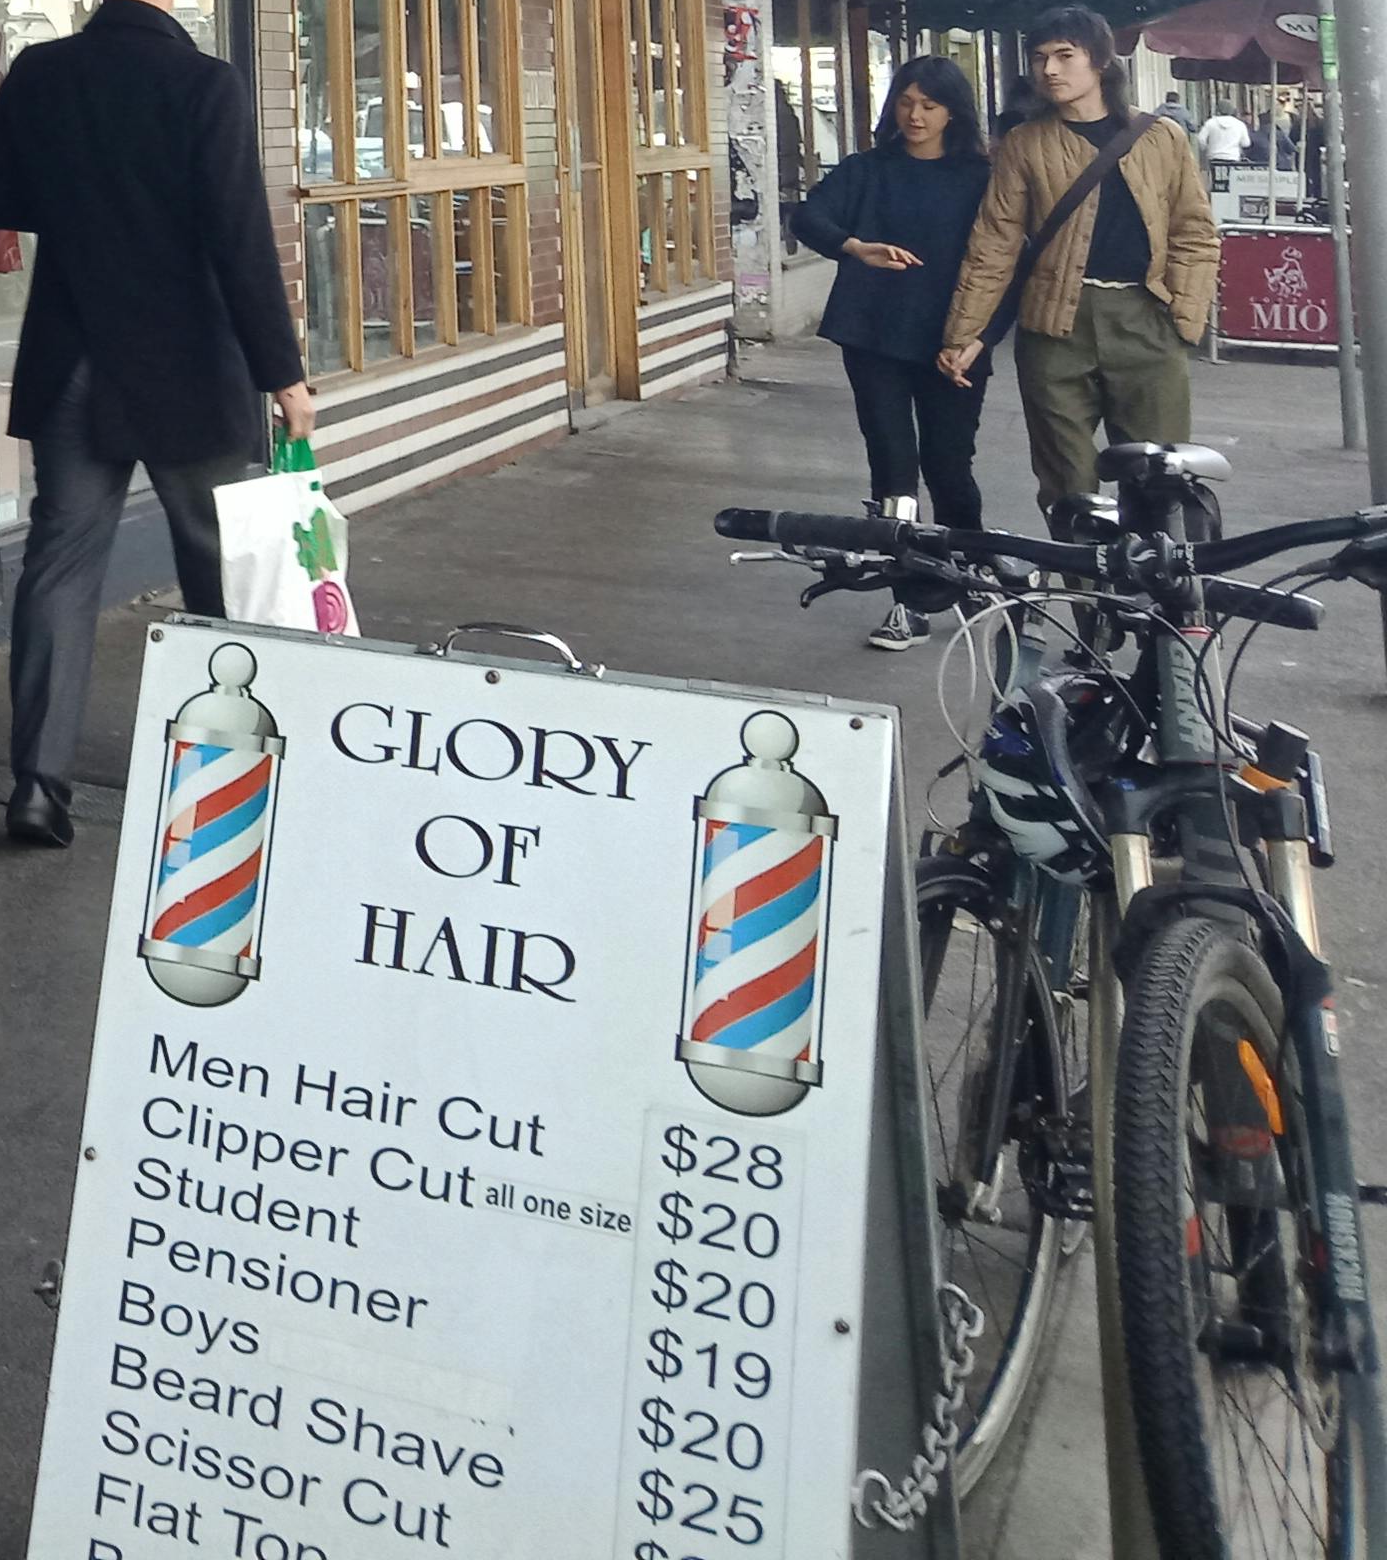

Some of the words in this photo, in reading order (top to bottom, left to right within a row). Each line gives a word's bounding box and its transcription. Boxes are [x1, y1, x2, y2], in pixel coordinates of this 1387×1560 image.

[1285, 22, 1317, 33] MI
[1250, 302, 1328, 332] MIO
[330, 701, 653, 803] GLORY
[414, 814, 541, 887] OF
[354, 903, 576, 1003] HAIR
[148, 1033, 271, 1099] Men
[293, 1063, 418, 1128] Hair
[437, 1096, 547, 1157] Cut
[141, 1097, 349, 1178] Clipper
[369, 1147, 476, 1209] Cut
[485, 1182, 515, 1211] all
[524, 1194, 572, 1221] one
[579, 1203, 632, 1234] size
[660, 1123, 784, 1190] $28
[133, 1157, 361, 1249] Student
[657, 1190, 780, 1259] $20
[126, 1217, 429, 1330] Pensioner
[651, 1258, 776, 1329] $20
[117, 1280, 260, 1355] Boys
[646, 1327, 772, 1400] $19
[109, 1344, 284, 1431] Beard
[305, 1397, 506, 1489] Shave
[637, 1396, 764, 1471] $20
[93, 1473, 204, 1546] Flat
[100, 1409, 322, 1508] Scissor
[343, 1477, 452, 1549] Cut
[637, 1468, 764, 1545] $25
